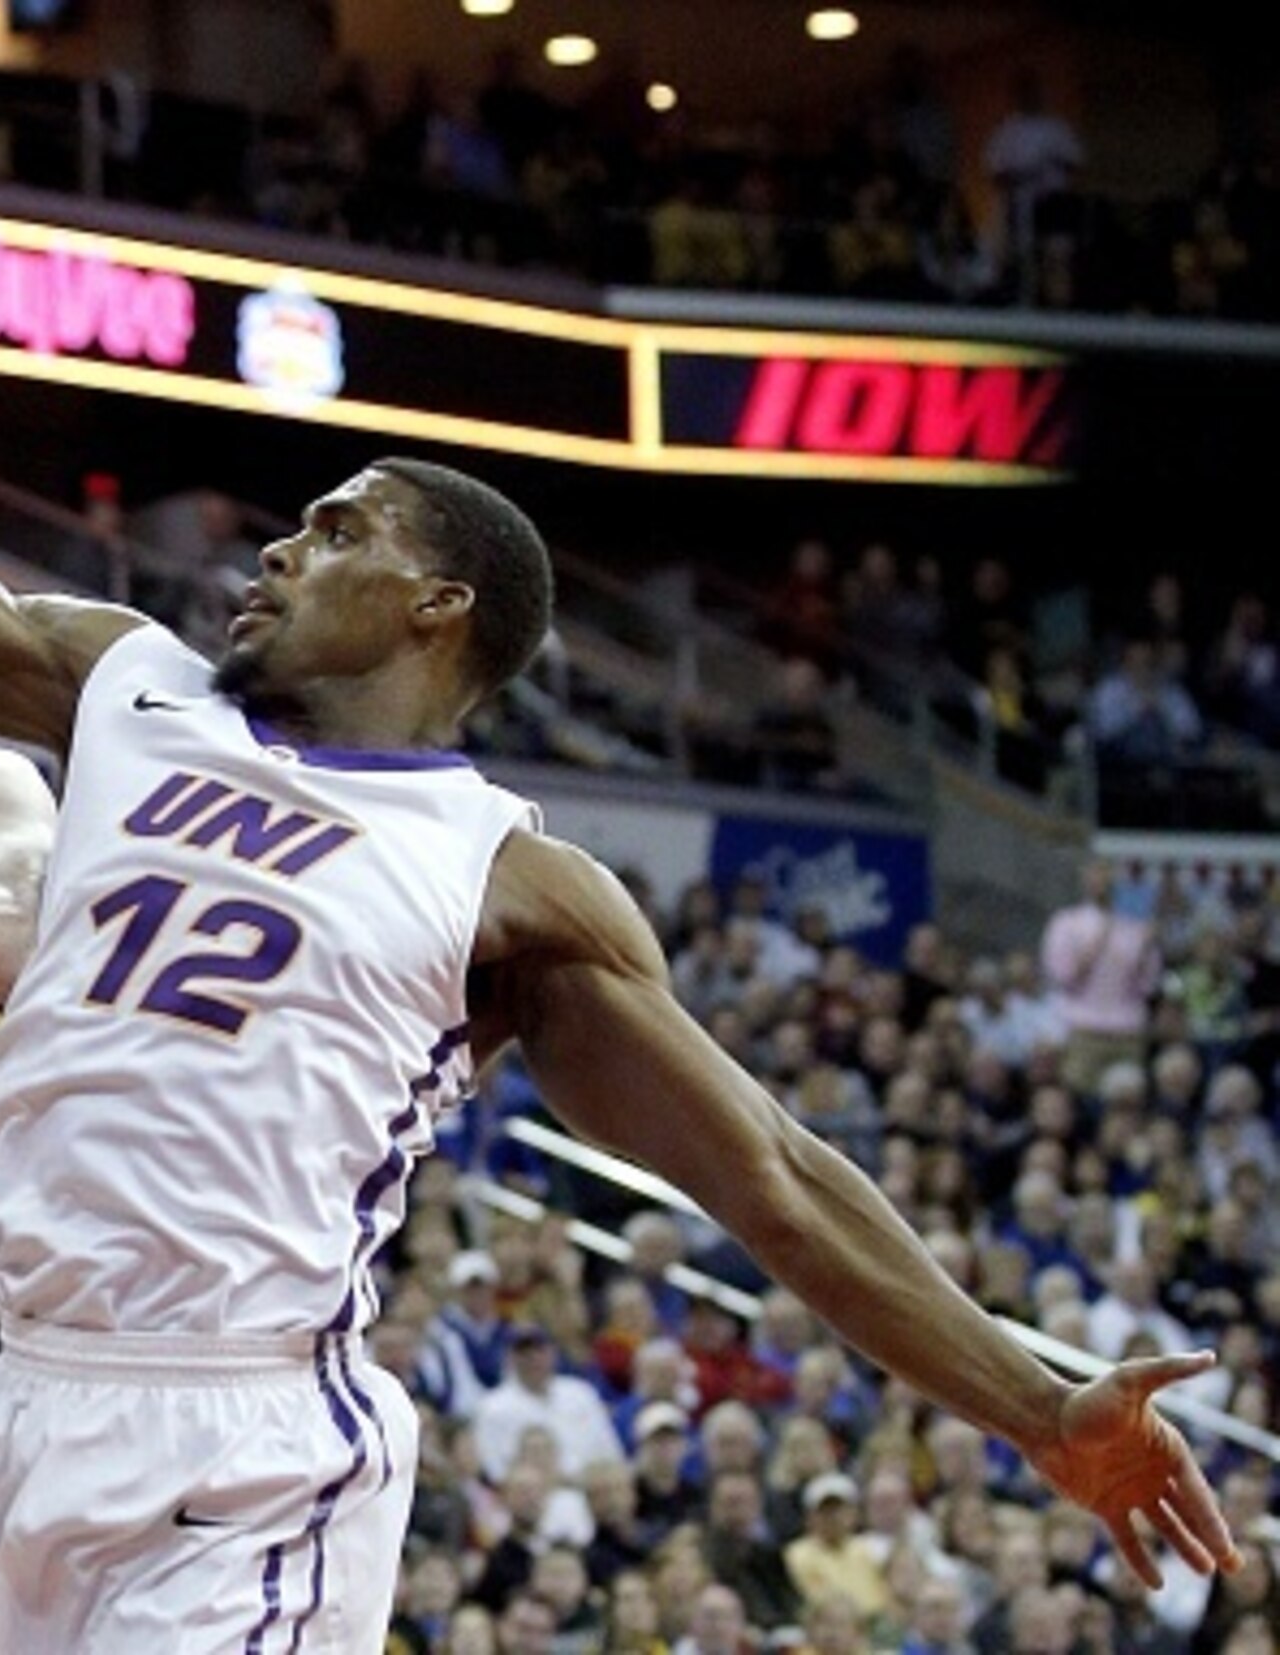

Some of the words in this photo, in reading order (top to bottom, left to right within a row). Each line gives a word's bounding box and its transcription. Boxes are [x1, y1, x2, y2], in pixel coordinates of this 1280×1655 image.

[733, 356, 1066, 464] IOW
[121, 771, 363, 880] UNI
[82, 872, 305, 1040] 12
